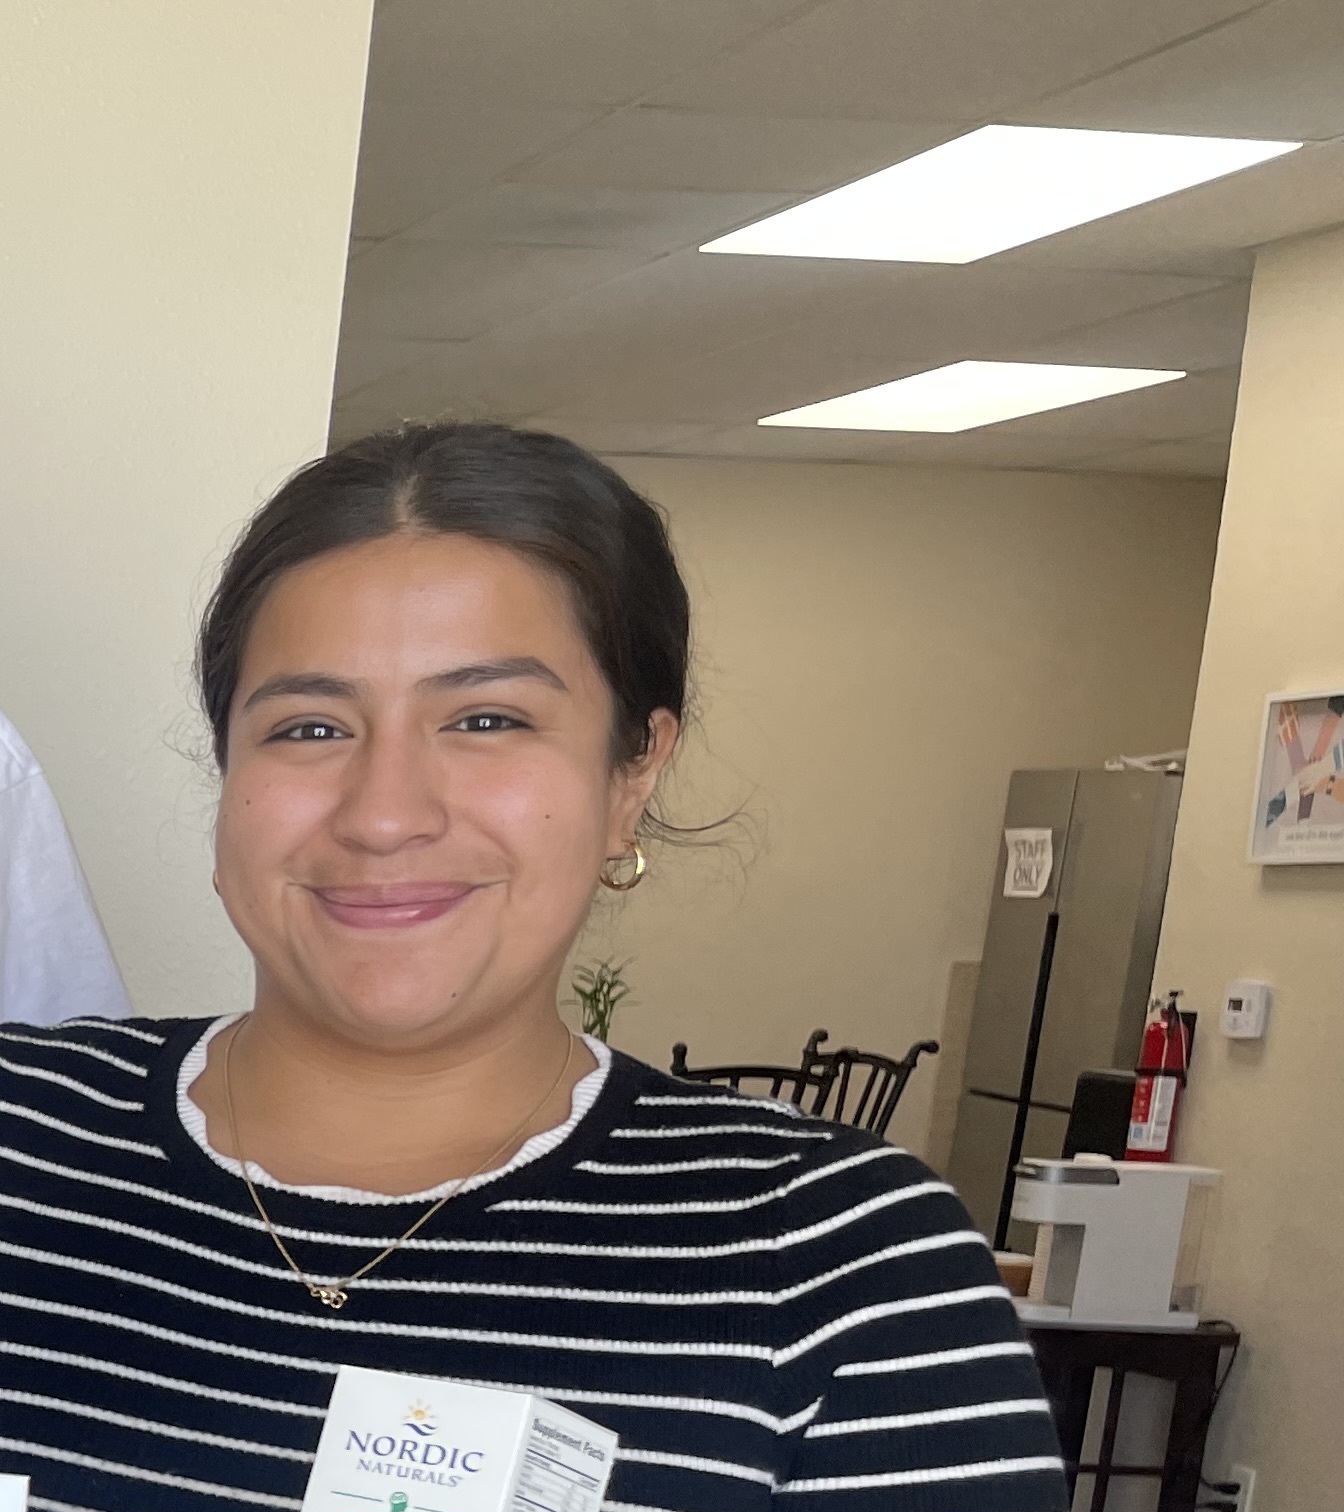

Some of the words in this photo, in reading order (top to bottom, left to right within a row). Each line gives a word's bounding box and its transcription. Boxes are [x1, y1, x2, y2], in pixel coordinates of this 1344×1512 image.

[1014, 838, 1046, 861] STAFF
[1013, 864, 1043, 888] ONLY
[346, 1430, 484, 1473] NORDIC
[356, 1459, 462, 1488] NATURALS
